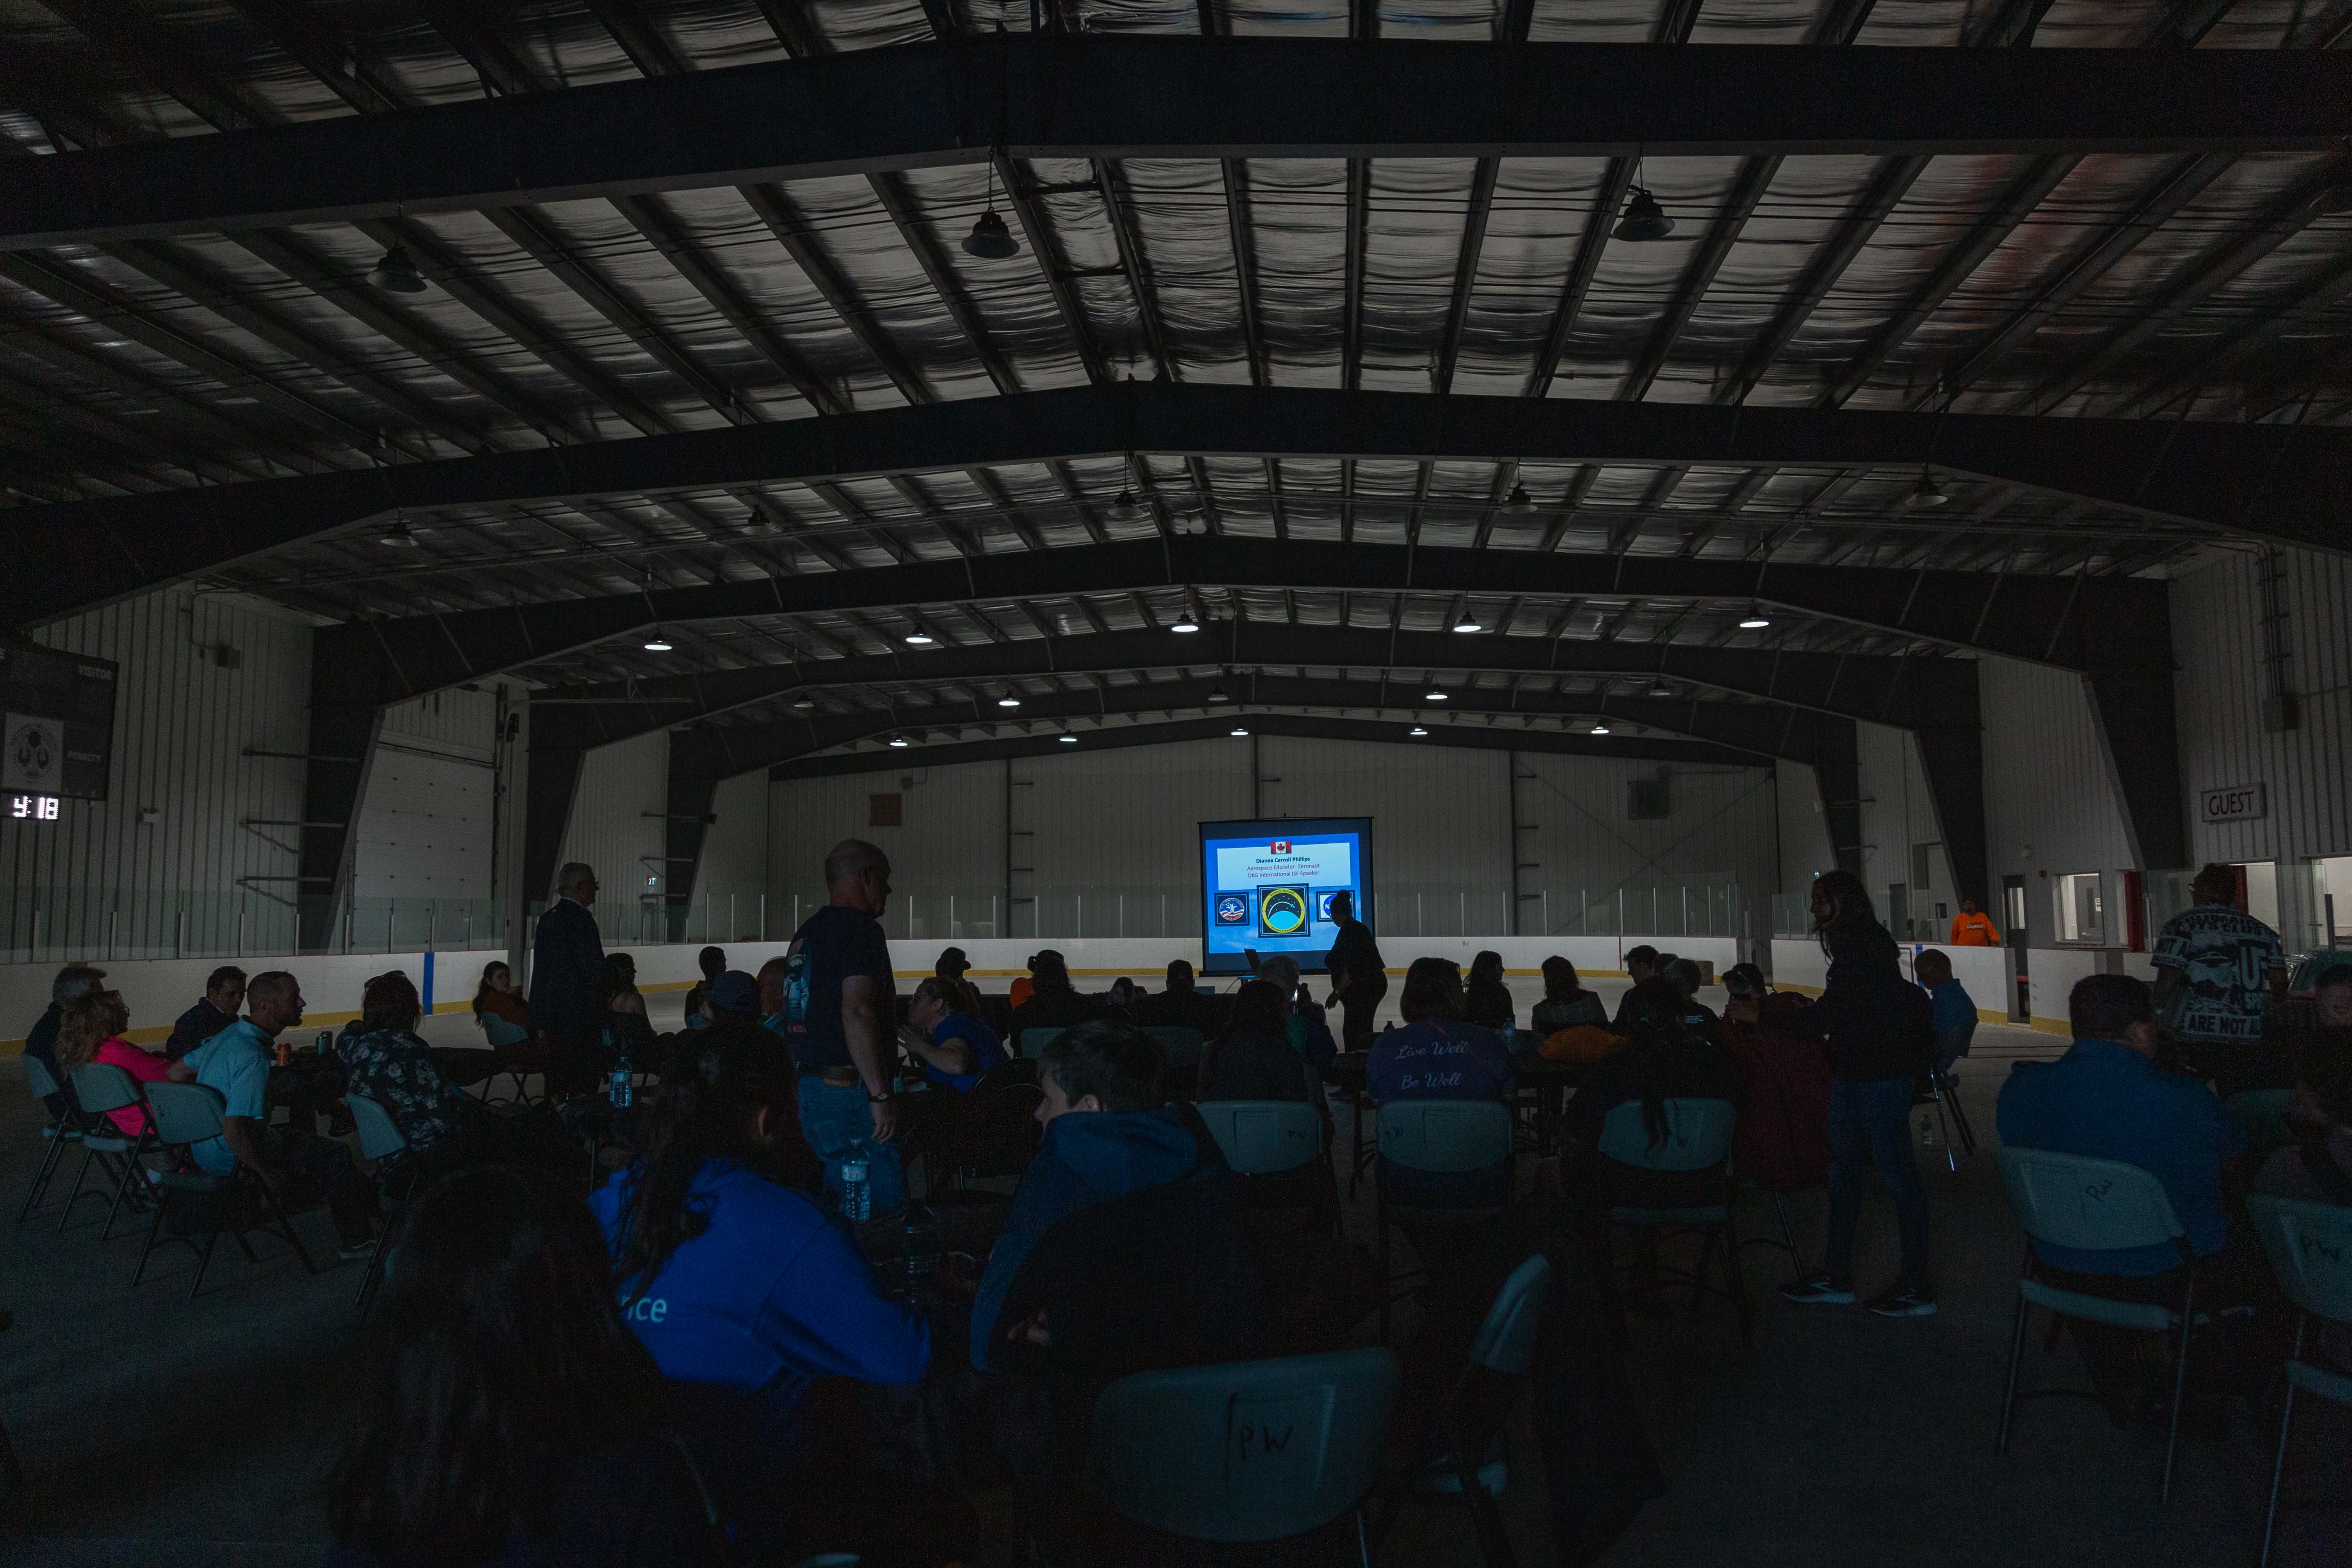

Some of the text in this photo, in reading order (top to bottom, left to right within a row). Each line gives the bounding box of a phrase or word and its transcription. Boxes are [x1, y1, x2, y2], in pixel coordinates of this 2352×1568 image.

[78, 665, 112, 681] VISITOR
[13, 796, 59, 819] 4:18
[2209, 791, 2254, 816] GUEST
[2188, 1014, 2215, 1032] ARE
[2219, 1017, 2247, 1035] NOT
[1395, 1040, 1468, 1060] Live Well
[1402, 1071, 1462, 1090] Be Well
[1239, 1424, 1295, 1460] PW
